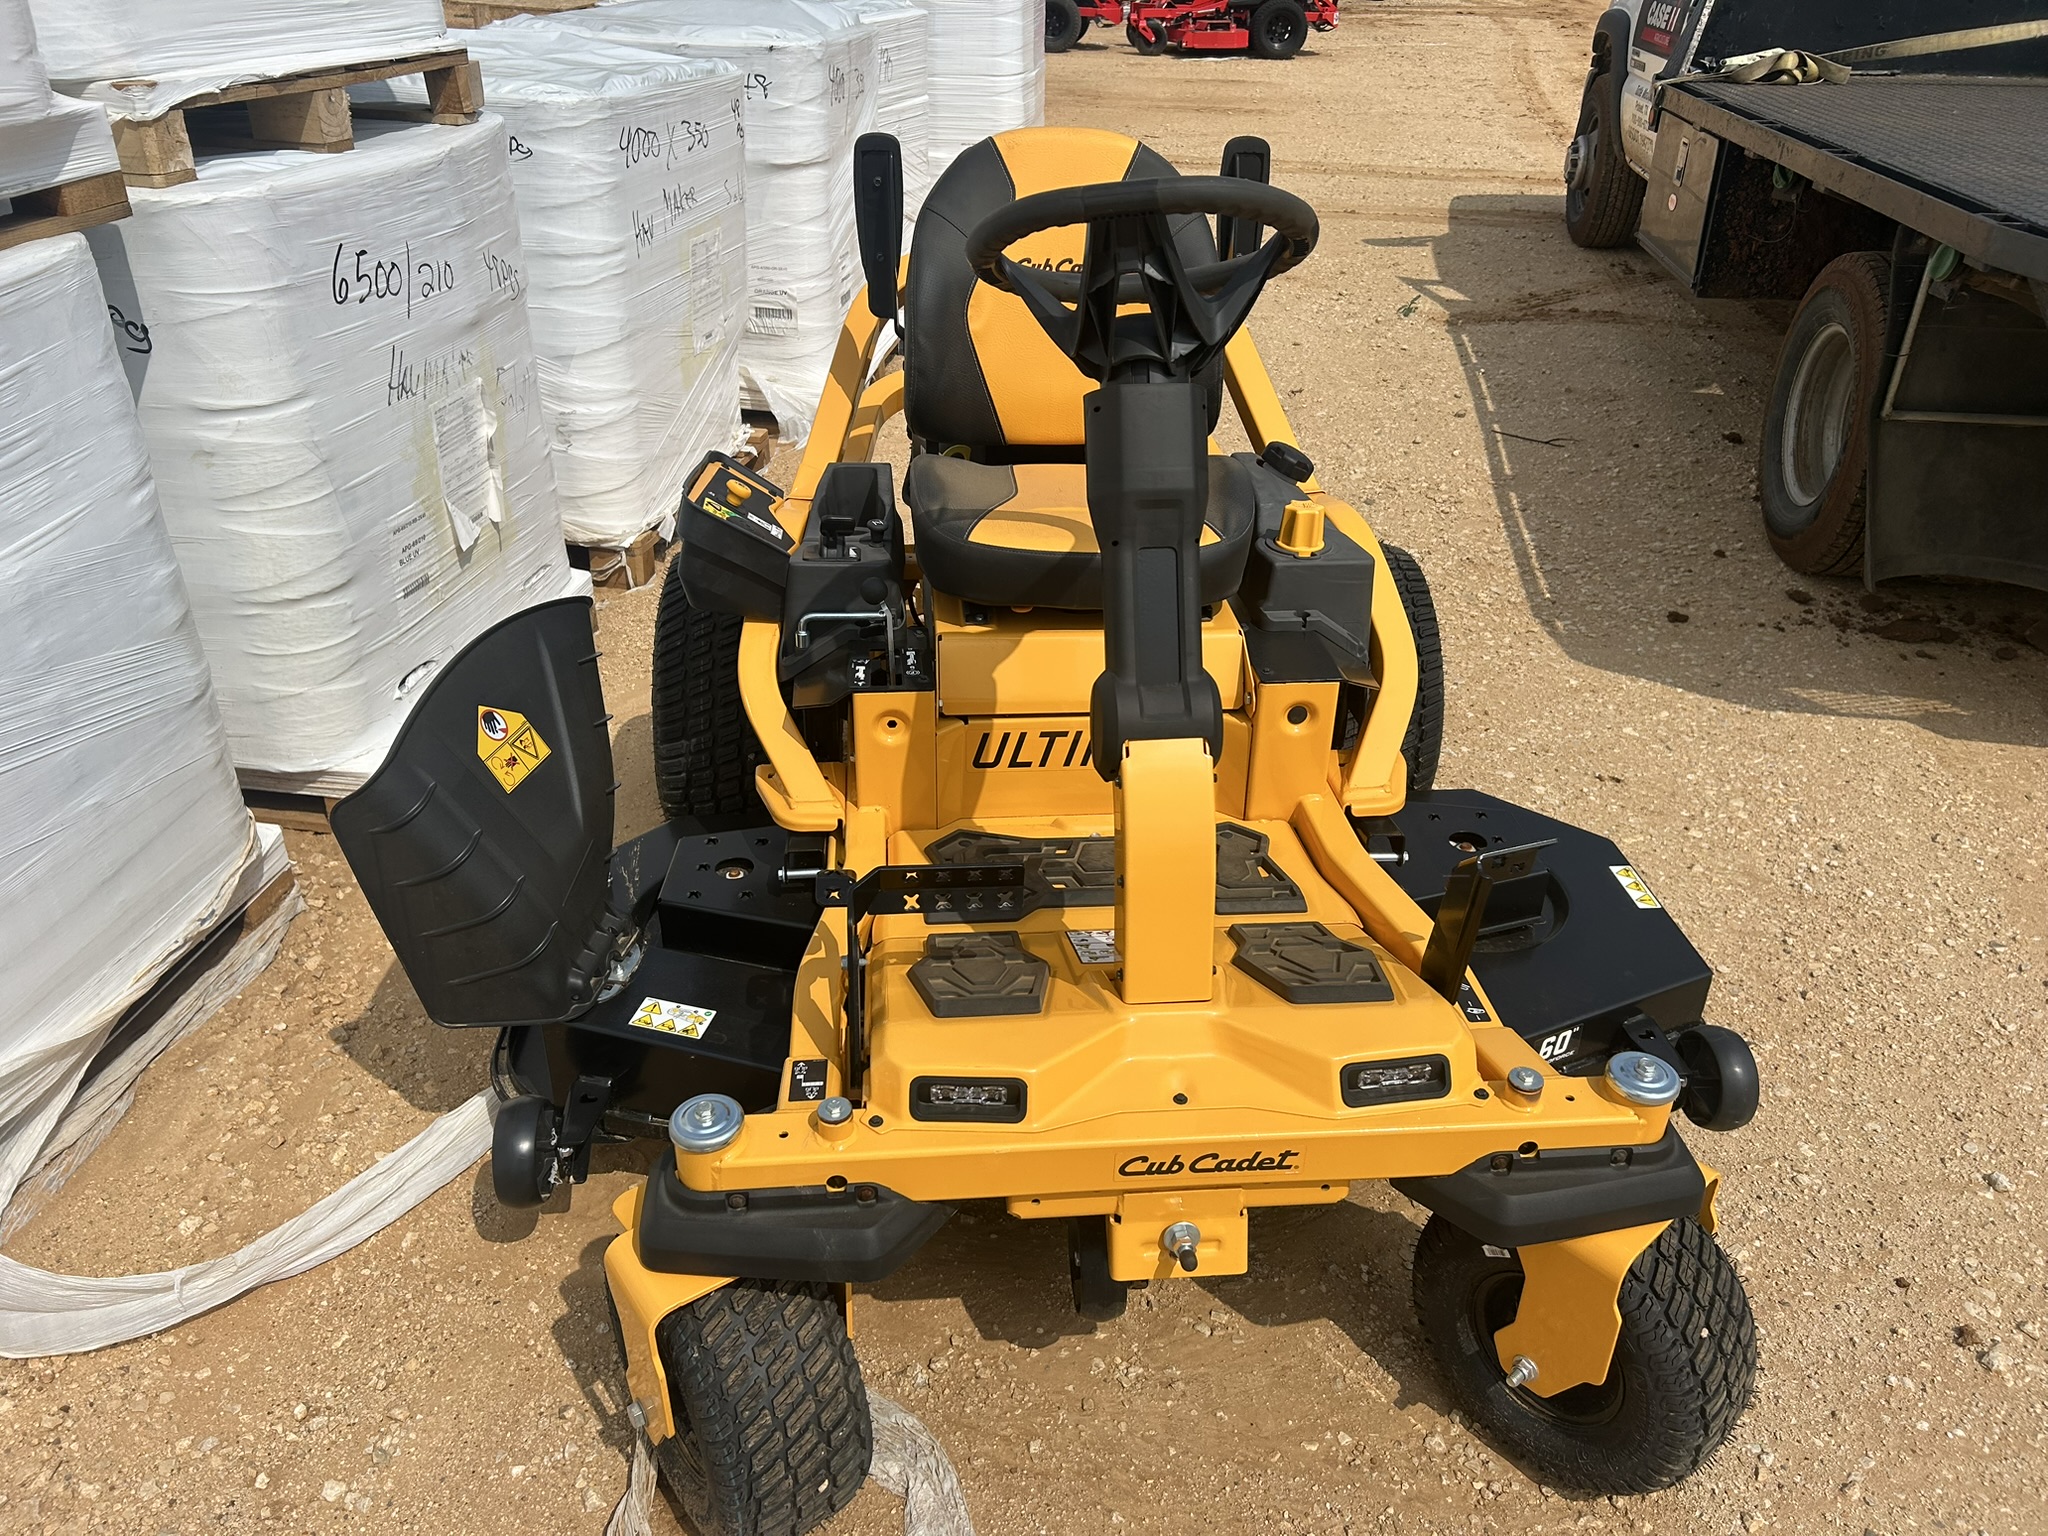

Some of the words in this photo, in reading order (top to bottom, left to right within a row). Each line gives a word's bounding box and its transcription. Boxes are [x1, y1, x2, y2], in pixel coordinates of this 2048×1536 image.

[1646, 0, 1673, 29] CASE
[618, 125, 661, 169] 4000
[680, 120, 710, 153] 350
[1117, 1154, 1186, 1177] Cub
[1188, 1149, 1300, 1173] Cadet
